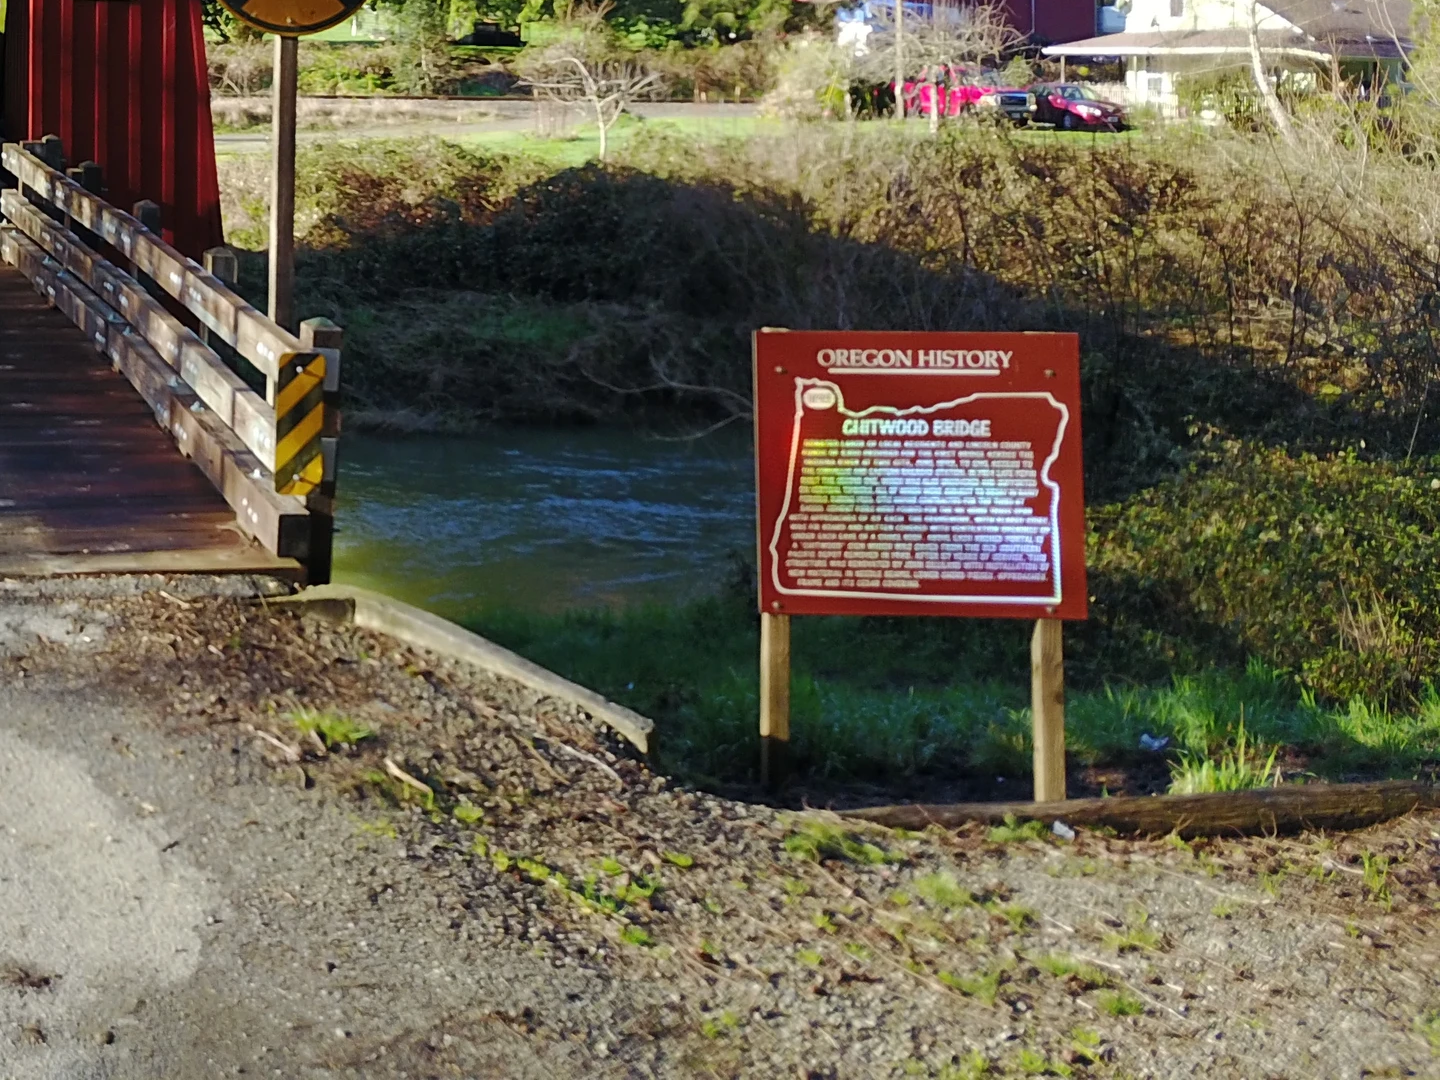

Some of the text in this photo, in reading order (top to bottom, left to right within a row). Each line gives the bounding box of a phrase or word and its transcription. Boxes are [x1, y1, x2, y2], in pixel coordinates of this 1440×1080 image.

[816, 348, 1014, 369] OREGON HISTORY
[841, 418, 992, 438] CHITWOOD BRIDGE
